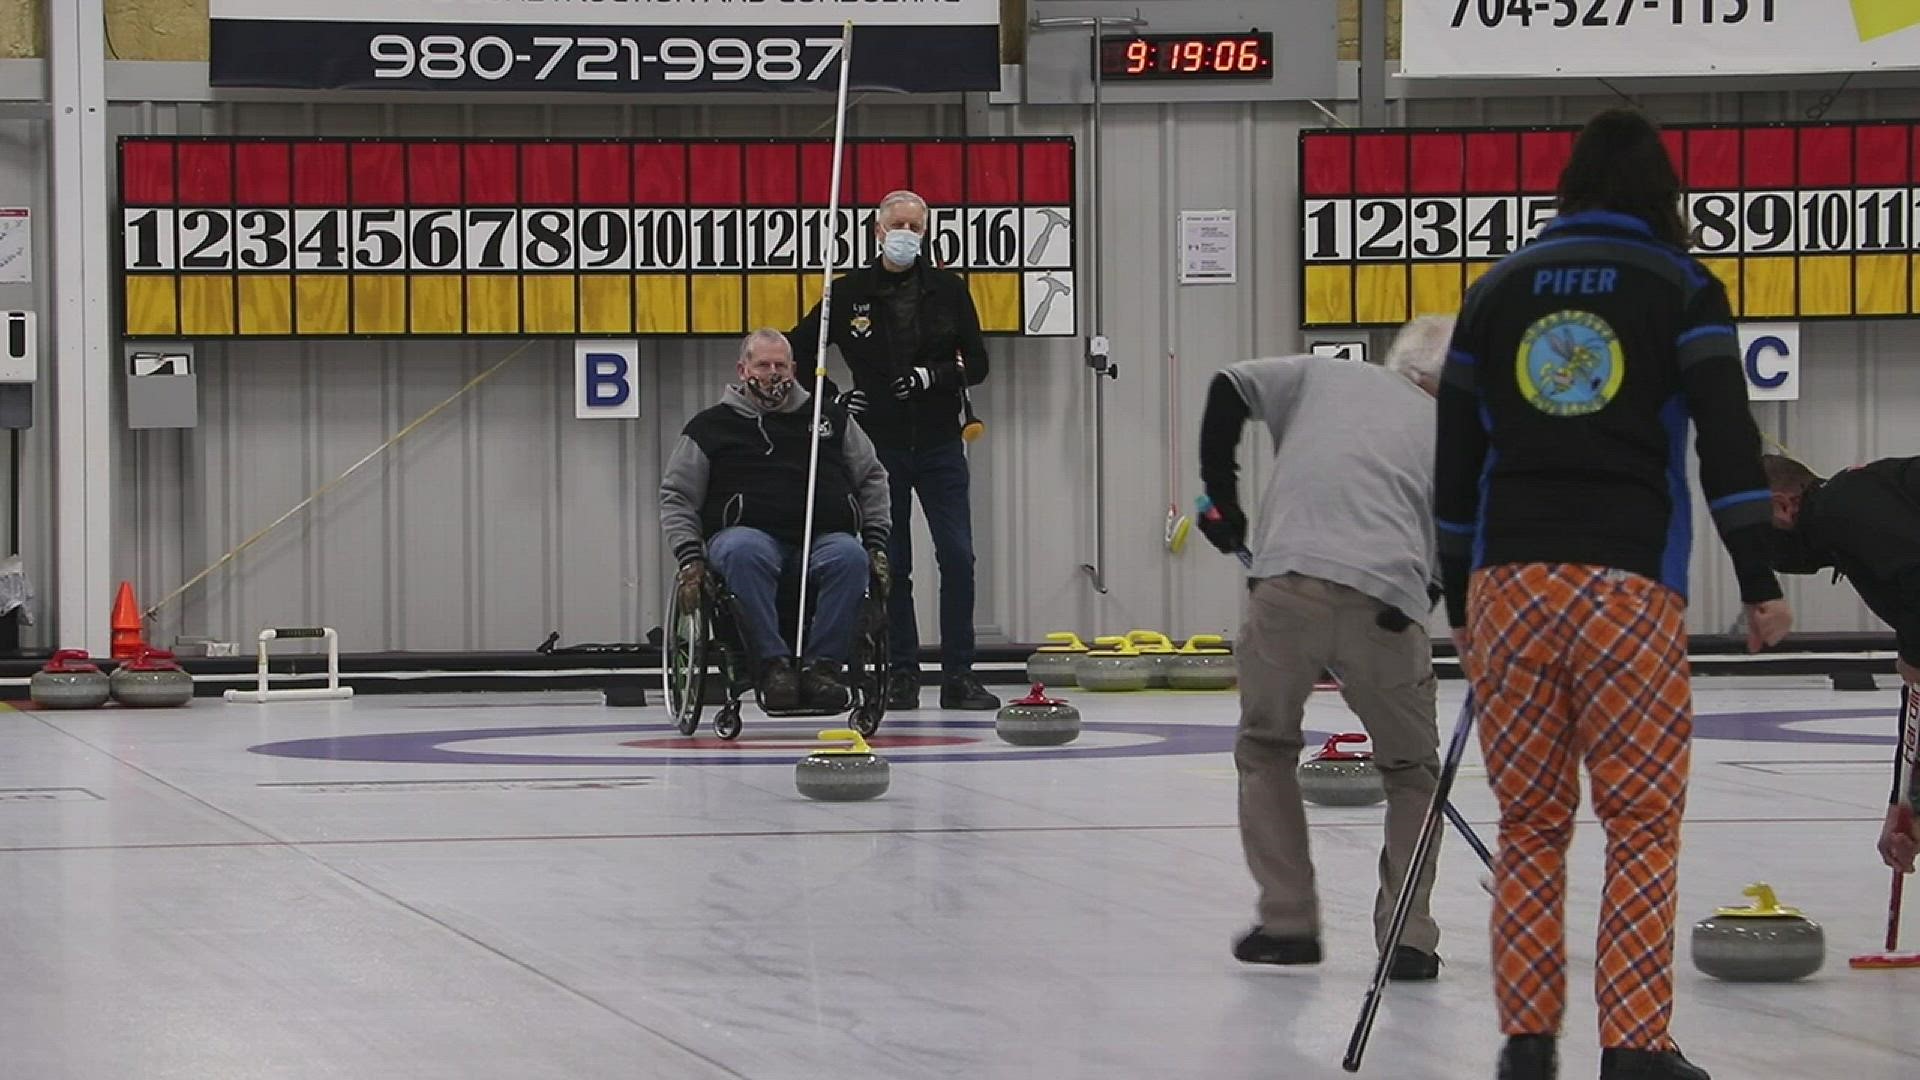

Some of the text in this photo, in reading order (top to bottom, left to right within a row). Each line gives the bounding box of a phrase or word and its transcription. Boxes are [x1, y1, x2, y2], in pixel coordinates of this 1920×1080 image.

[370, 34, 844, 81] 980-721-9987
[1127, 41, 1258, 73] 9:19:06
[128, 210, 162, 267] 1
[182, 210, 230, 267] 2
[240, 210, 288, 267] 3
[298, 210, 345, 267] 4
[356, 210, 402, 267] 5
[412, 211, 459, 267] 6
[469, 211, 515, 267] 7
[525, 211, 572, 267] 8
[581, 211, 627, 267] 9
[637, 210, 684, 267] 10
[694, 210, 740, 267] 11
[749, 210, 795, 267] 12
[804, 210, 850, 267] 13
[970, 209, 1016, 266] 16
[1308, 201, 1340, 258] 1
[1359, 201, 1404, 257] 2
[1413, 200, 1459, 256] 3
[1468, 199, 1514, 255] 4
[1692, 195, 1736, 250] 8
[1747, 194, 1792, 250] 9
[1803, 193, 1848, 250] 10
[1859, 191, 1905, 248] 11
[1532, 266, 1619, 296] PIFER
[586, 353, 630, 407] B
[1745, 335, 1790, 389] C
